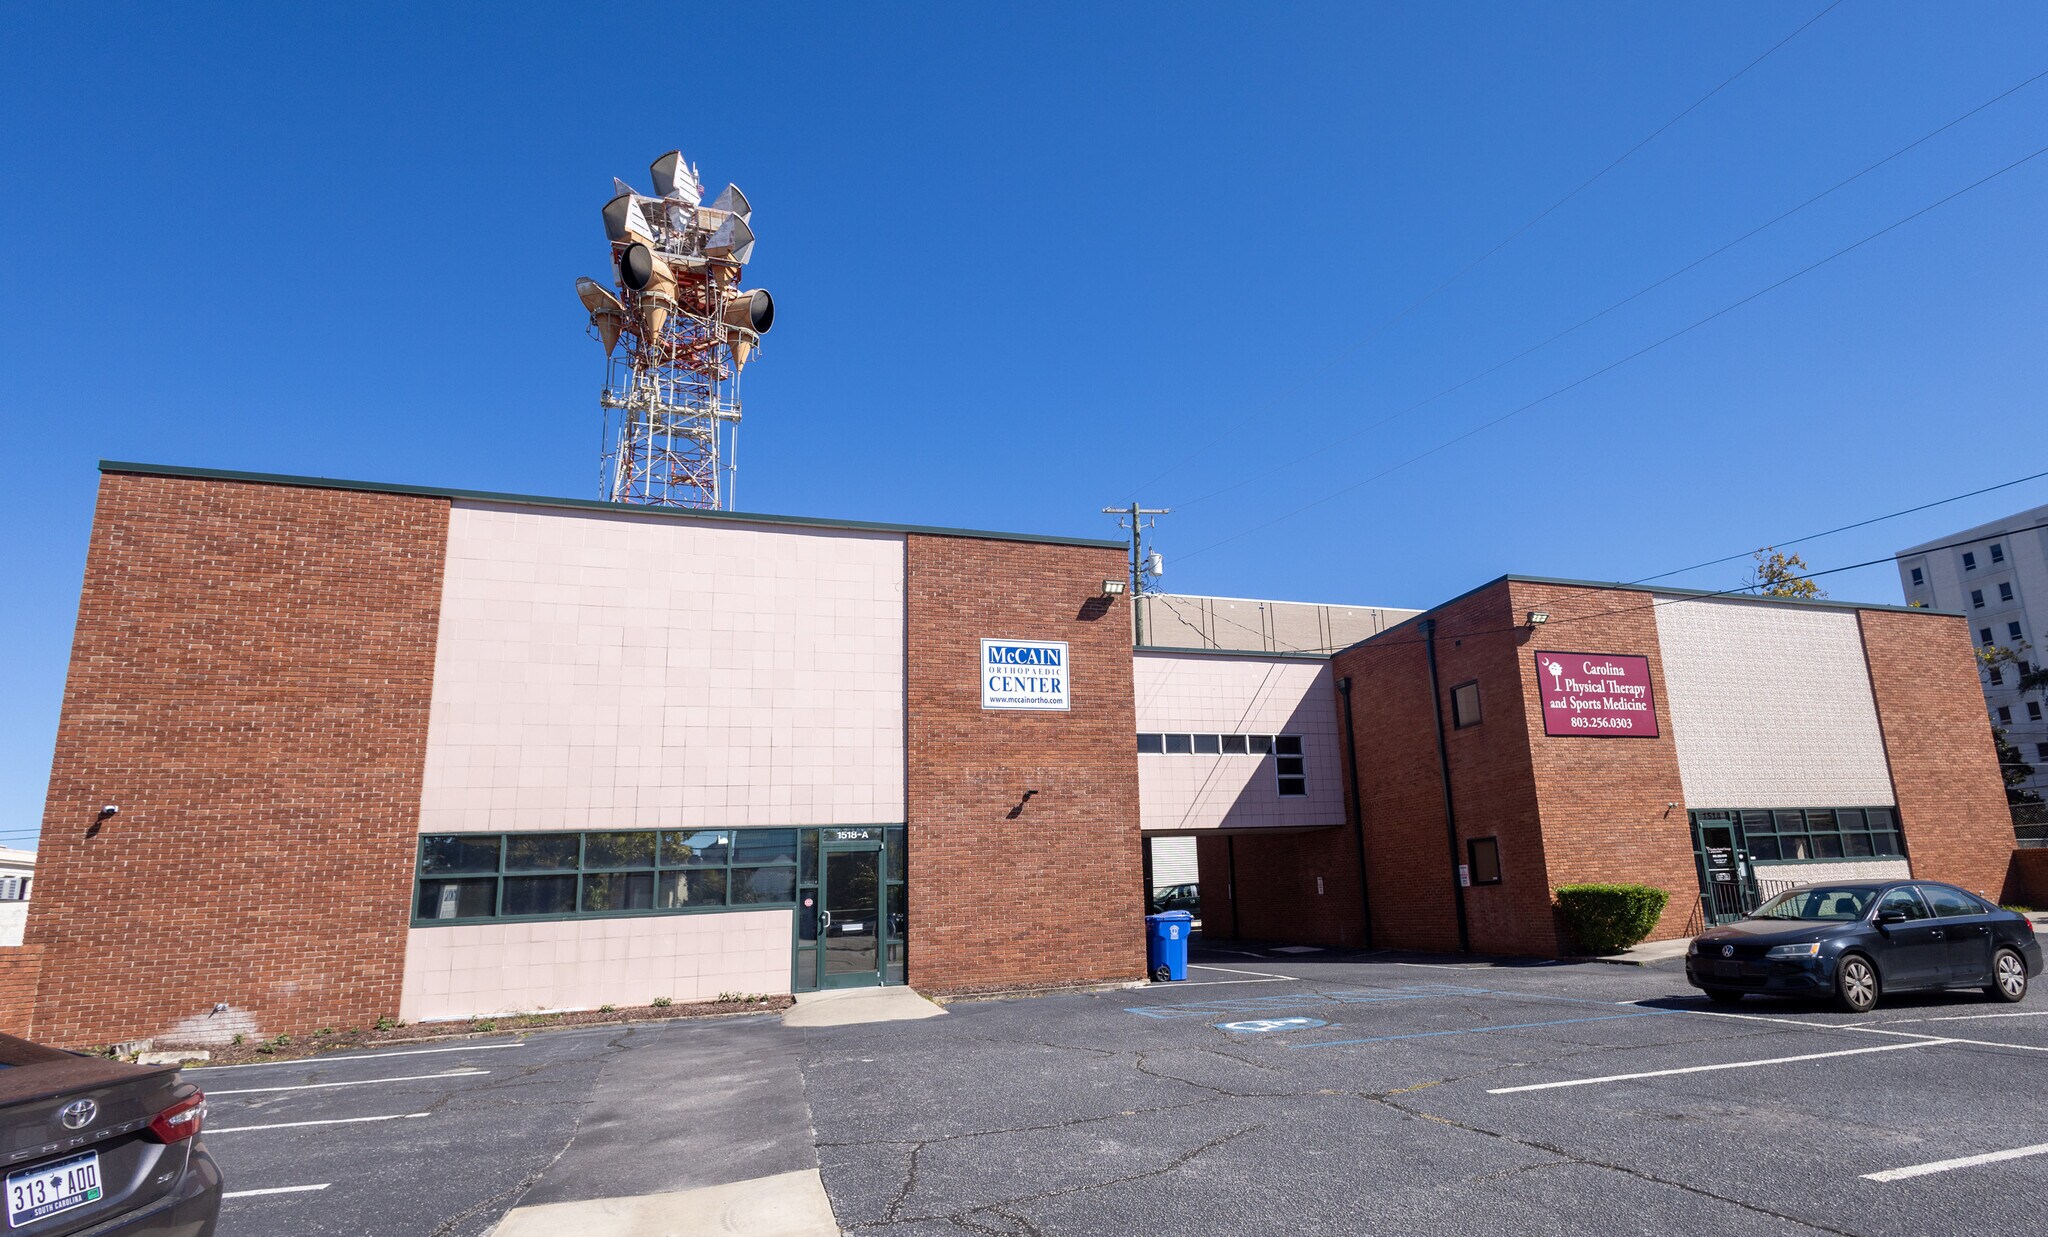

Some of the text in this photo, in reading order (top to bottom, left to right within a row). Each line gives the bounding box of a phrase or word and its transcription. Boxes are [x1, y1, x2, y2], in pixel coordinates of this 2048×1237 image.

[990, 647, 1060, 665] McCAIN
[989, 666, 1061, 676] ORTHOPAEDIC
[1583, 661, 1625, 676] Carolina
[989, 676, 1062, 693] CENTER
[1565, 678, 1646, 698] Physical Therapy
[989, 696, 1063, 704] www.mccainortho.com
[1550, 696, 1647, 713] and Sports Medicine
[1571, 717, 1632, 729] 803.256.0303
[837, 831, 869, 839] 1518-A
[14, 1180, 46, 1210] 313
[34, 1194, 83, 1216] SOUTH CAROLINA
